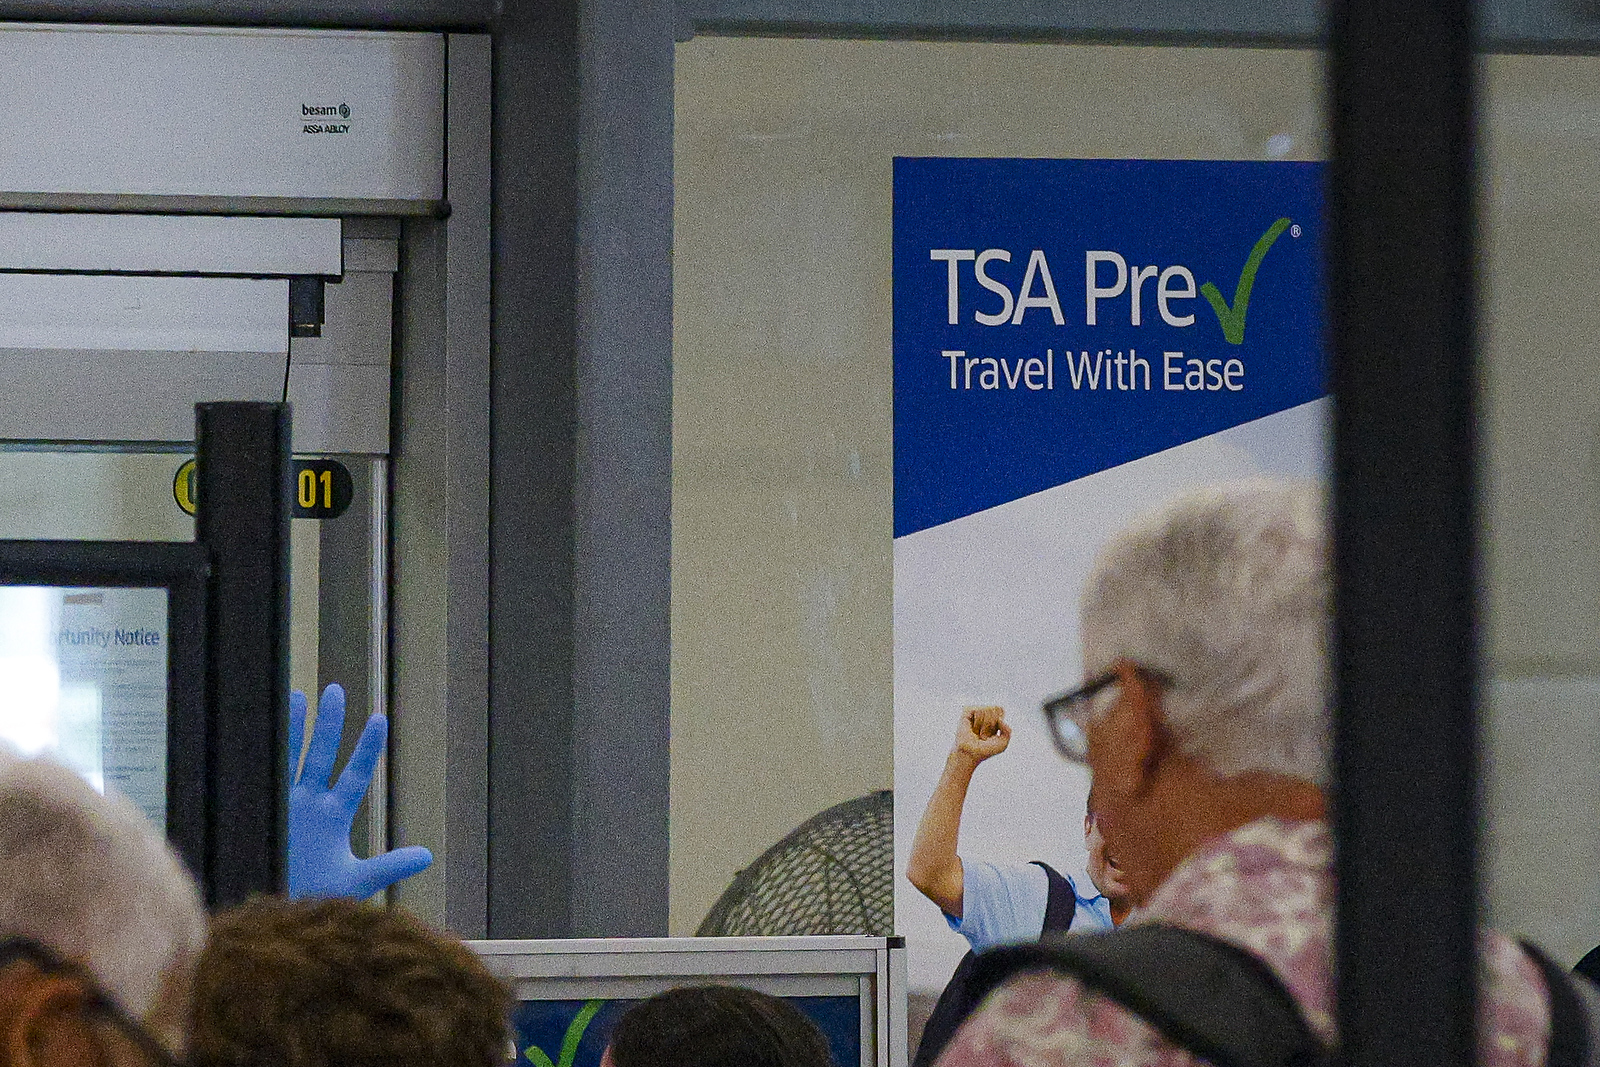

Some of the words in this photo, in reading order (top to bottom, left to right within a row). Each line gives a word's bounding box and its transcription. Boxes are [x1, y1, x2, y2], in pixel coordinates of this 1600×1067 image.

[302, 103, 337, 116] besam
[302, 124, 323, 134] ASSA
[324, 124, 351, 134] ABLOY
[929, 248, 1066, 327] TSA
[1085, 250, 1197, 328] Pre
[941, 348, 1053, 391] Travel
[1066, 348, 1151, 391] With
[1163, 351, 1245, 392] Ease
[297, 468, 333, 509] 01
[113, 626, 161, 647] Notice
